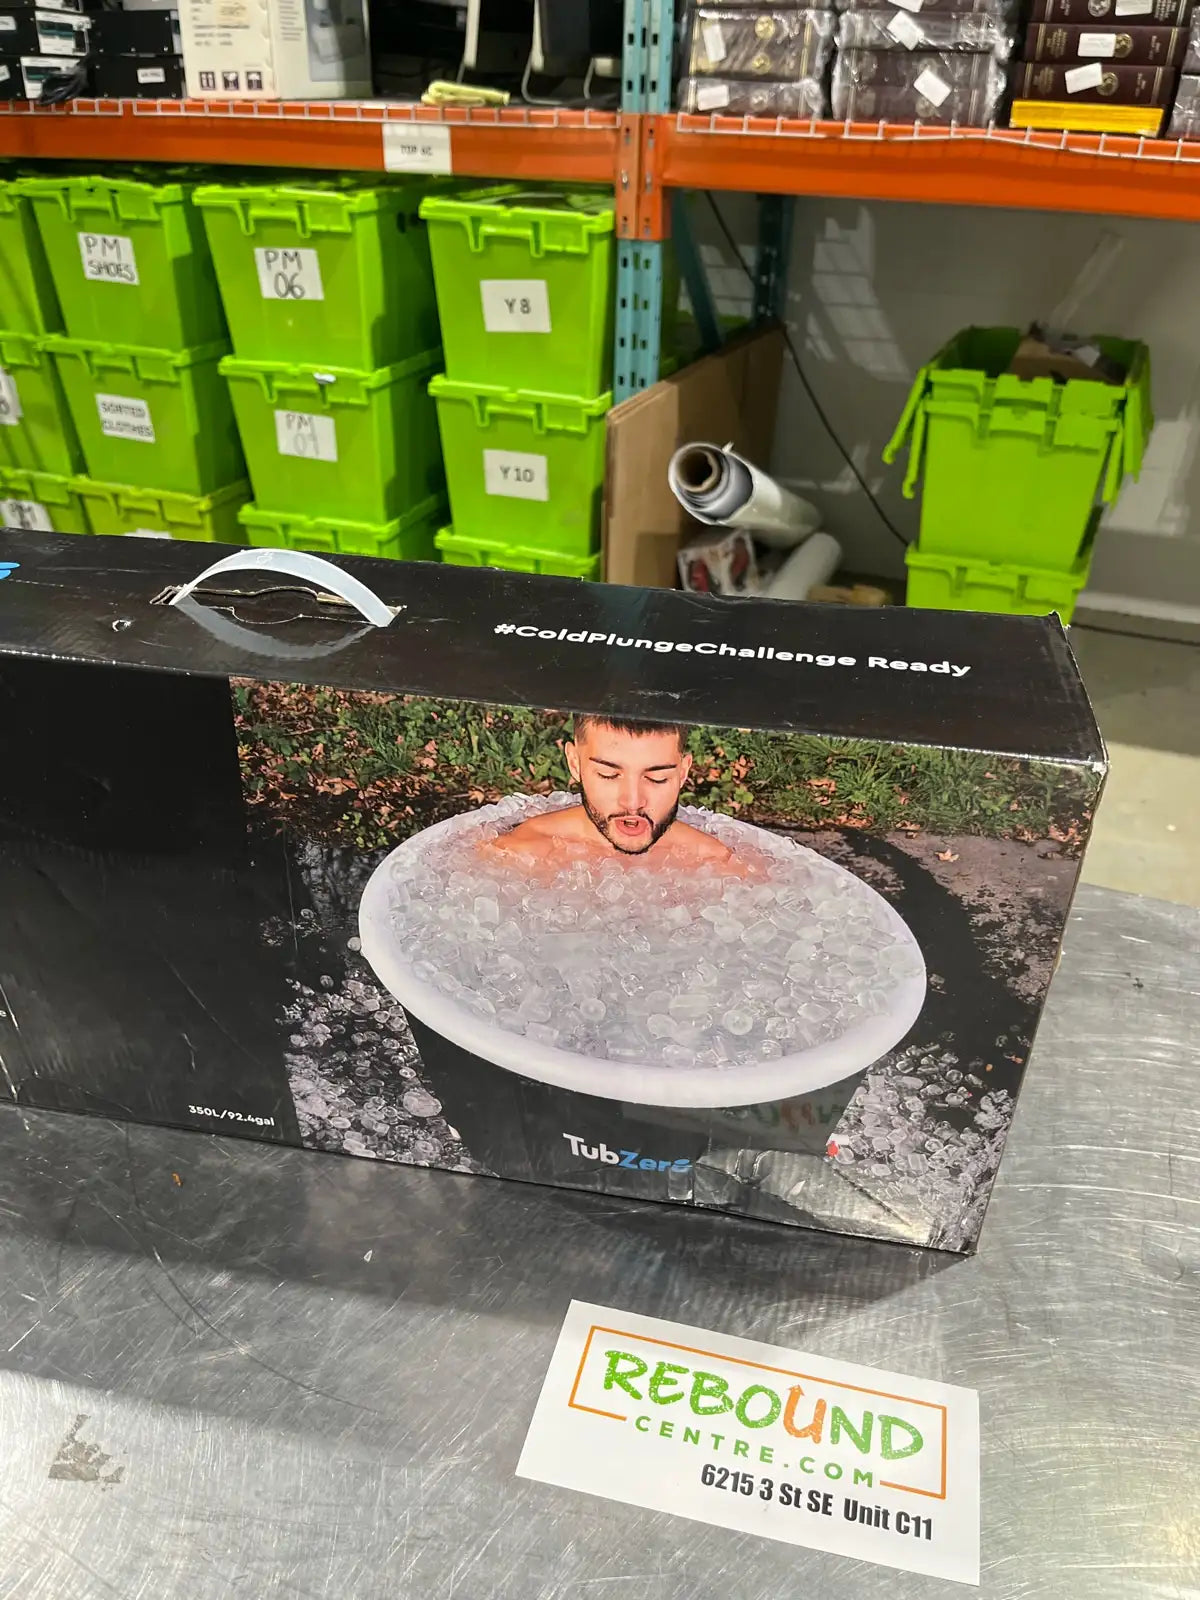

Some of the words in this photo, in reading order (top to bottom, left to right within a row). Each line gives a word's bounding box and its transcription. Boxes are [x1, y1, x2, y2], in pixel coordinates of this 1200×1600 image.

[84, 236, 121, 261] PM
[264, 250, 302, 271] PM
[88, 260, 136, 281] SHOES
[274, 271, 305, 299] 06
[504, 298, 516, 314] Y
[520, 298, 531, 314] 8
[500, 466, 510, 480] Y
[514, 468, 535, 482] 10
[493, 623, 857, 667] #ColdPlungeChallenge
[867, 655, 972, 678] Ready
[188, 1104, 275, 1127] 350L/92.4gal
[603, 1349, 925, 1461] REBOUND
[635, 1415, 874, 1488] CENTRE.COM
[701, 1463, 754, 1496] 6215
[759, 1478, 774, 1501] 3
[778, 1482, 802, 1509] St
[806, 1489, 833, 1516] SE
[843, 1497, 890, 1530] Unit
[895, 1510, 932, 1540] C11
